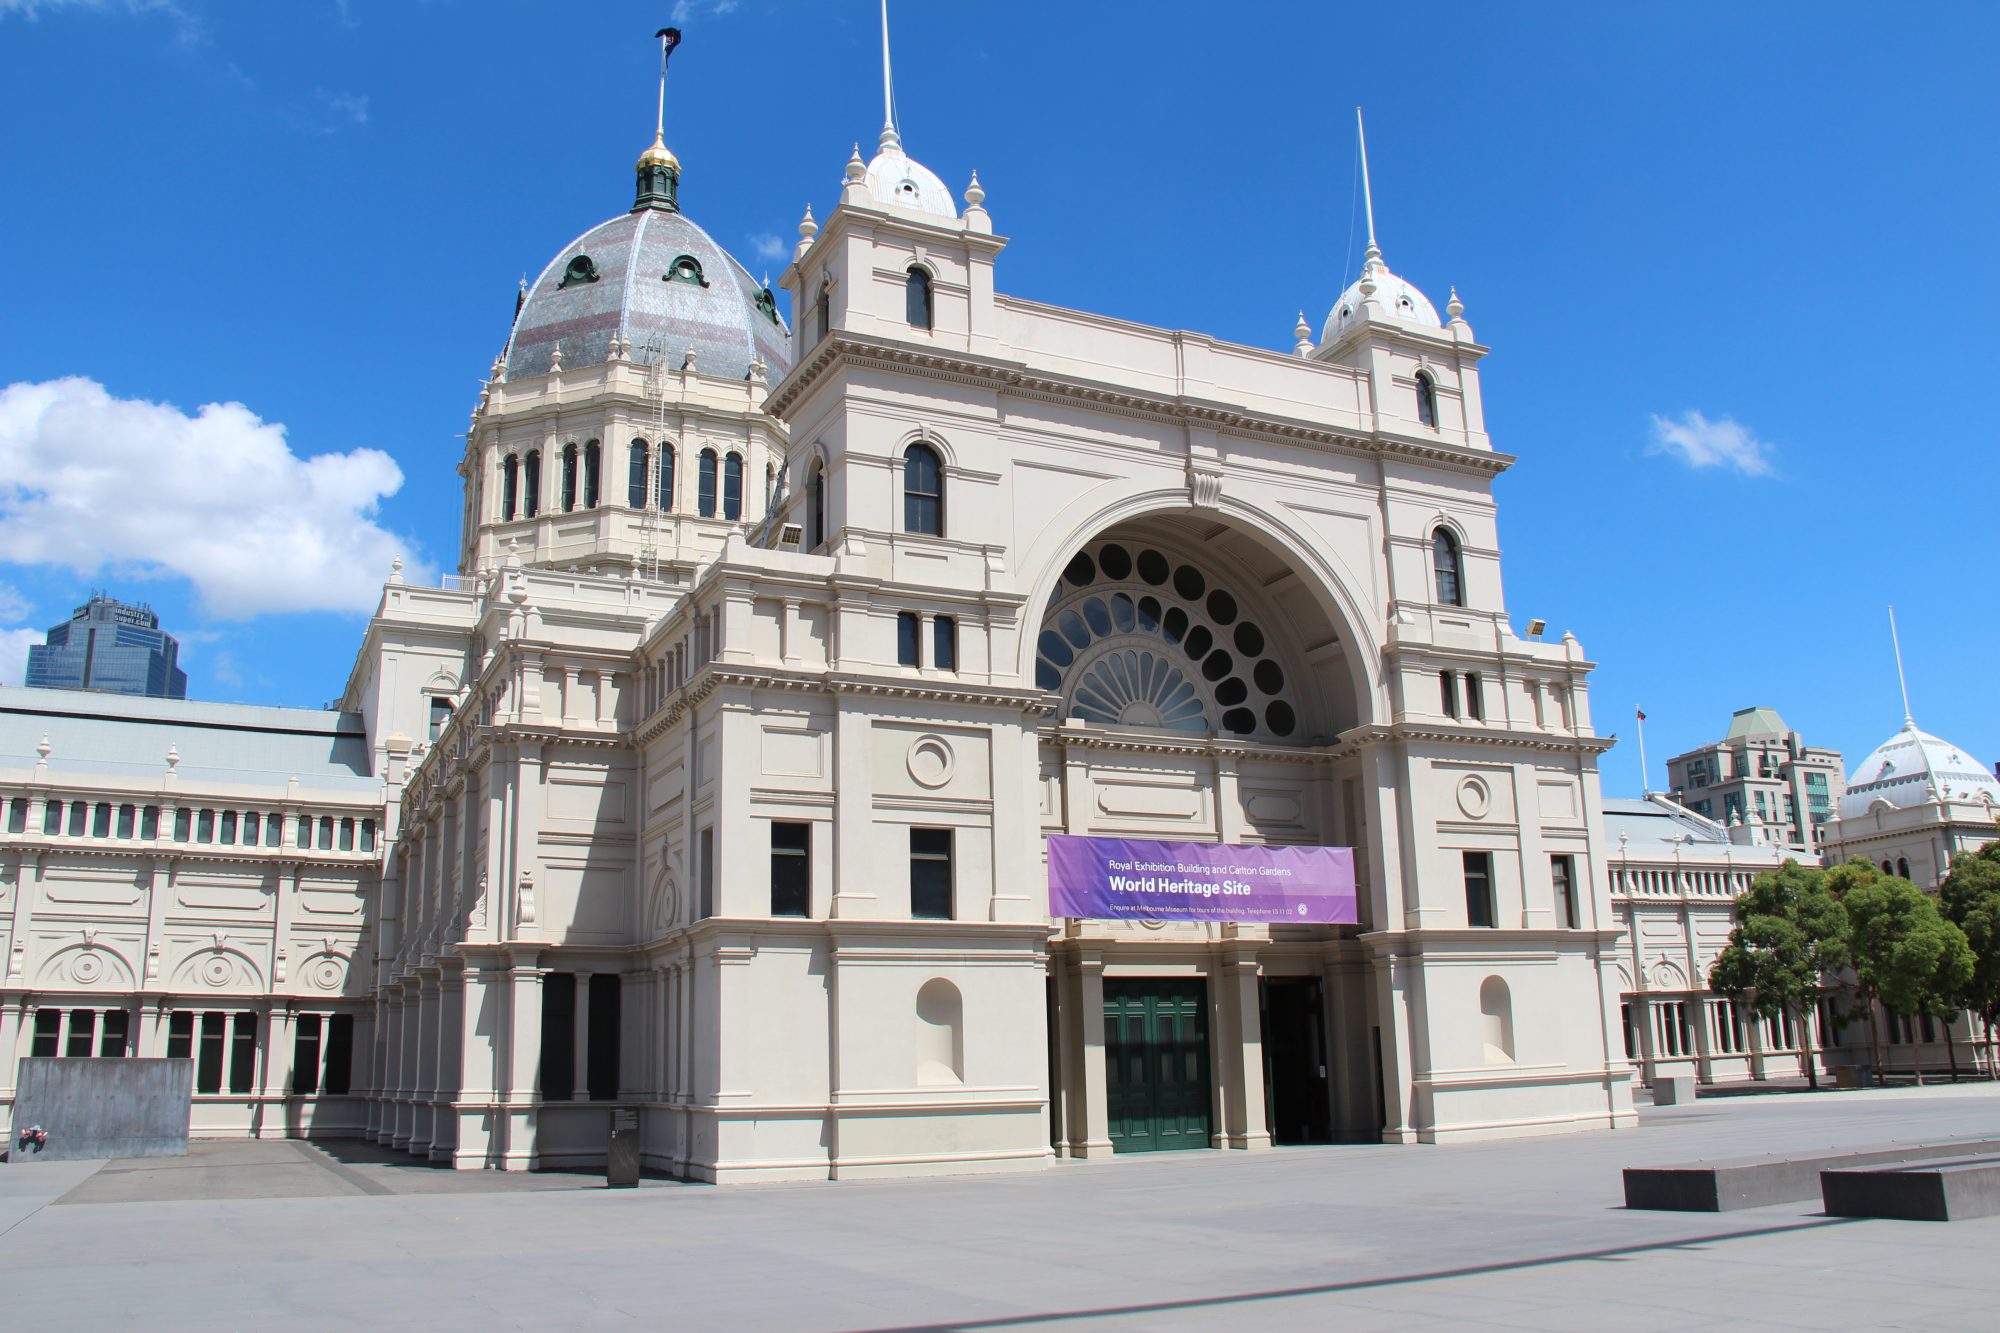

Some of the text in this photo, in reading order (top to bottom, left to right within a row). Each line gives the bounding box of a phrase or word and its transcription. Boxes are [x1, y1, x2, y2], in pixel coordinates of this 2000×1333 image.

[1109, 860, 1292, 877] Royal Exhibition Building and Carlton Gardens
[1109, 875, 1251, 898] World Heritage Site
[1109, 904, 1130, 912] Enquire
